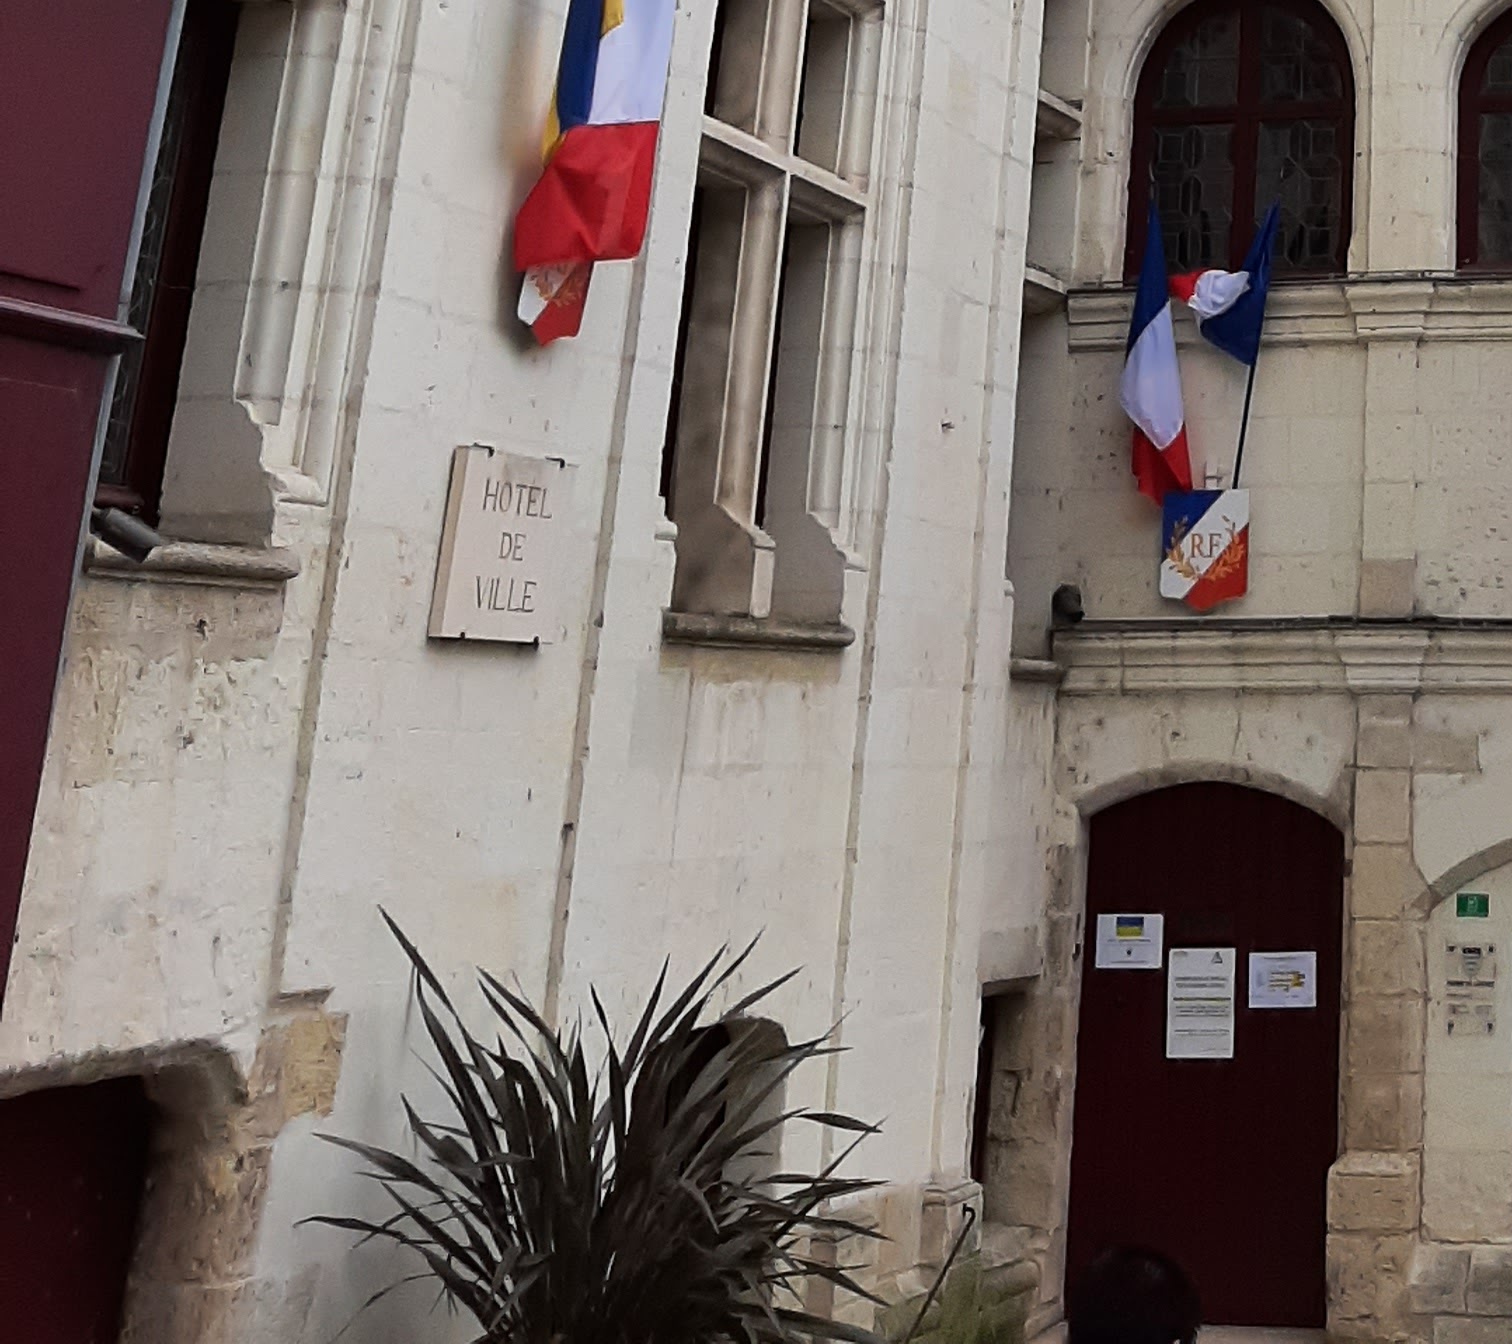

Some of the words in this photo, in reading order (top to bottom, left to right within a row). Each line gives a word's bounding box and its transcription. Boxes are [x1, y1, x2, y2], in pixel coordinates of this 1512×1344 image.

[498, 531, 527, 562] DE
[1190, 532, 1222, 558] RF
[475, 575, 537, 613] VILLE
